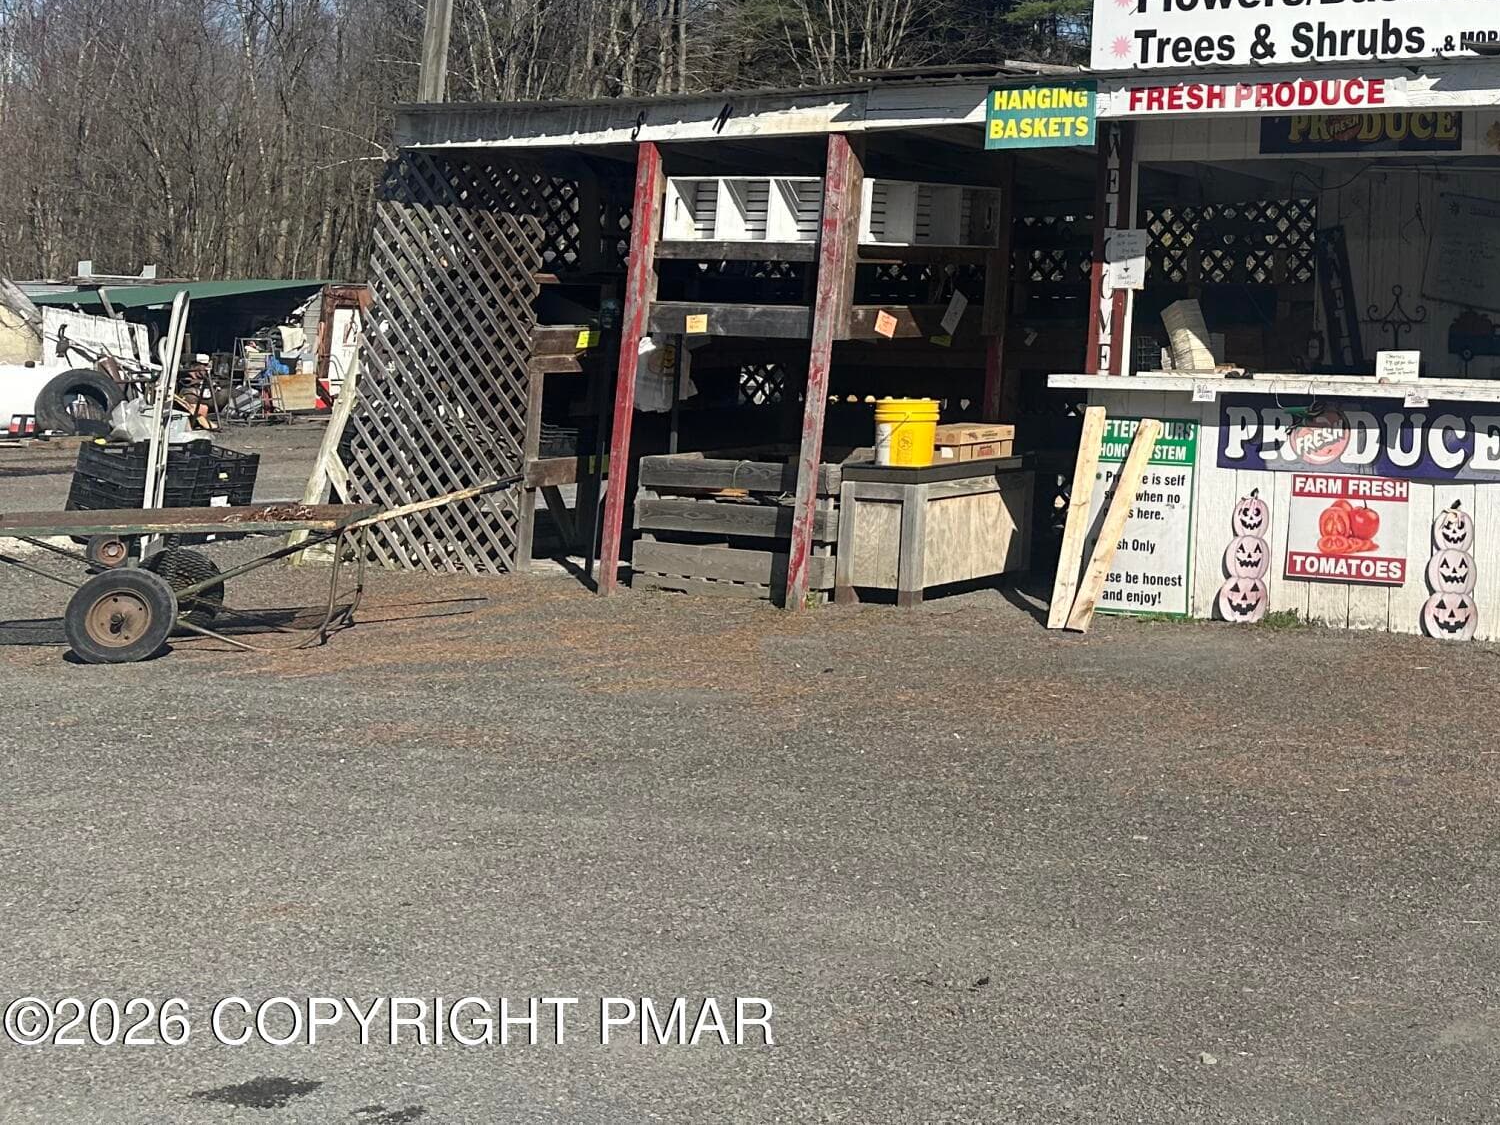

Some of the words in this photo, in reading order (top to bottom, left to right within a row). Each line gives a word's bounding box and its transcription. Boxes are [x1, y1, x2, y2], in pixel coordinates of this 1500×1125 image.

[1134, 29, 1236, 64] Trees
[1250, 23, 1276, 60] &
[1291, 18, 1425, 58] Shrubs
[993, 87, 1088, 111] HANGING
[1129, 82, 1227, 111] FRESH
[1235, 77, 1386, 108] PRODUCE
[989, 116, 1089, 139] BASKETS
[1297, 420, 1344, 455] FRESH
[1151, 473, 1161, 485] is
[1164, 474, 1186, 487] self
[1295, 477, 1342, 494] FARM
[1348, 479, 1408, 498] FRESH
[1135, 490, 1163, 503] when
[1166, 493, 1181, 503] no
[1137, 508, 1164, 520] here.
[1132, 539, 1156, 554] Only
[1292, 555, 1402, 579] TOMATOES
[1125, 571, 1139, 584] be
[1143, 573, 1183, 587] honest
[1102, 589, 1123, 601] and
[1126, 591, 1162, 606] enjoy!
